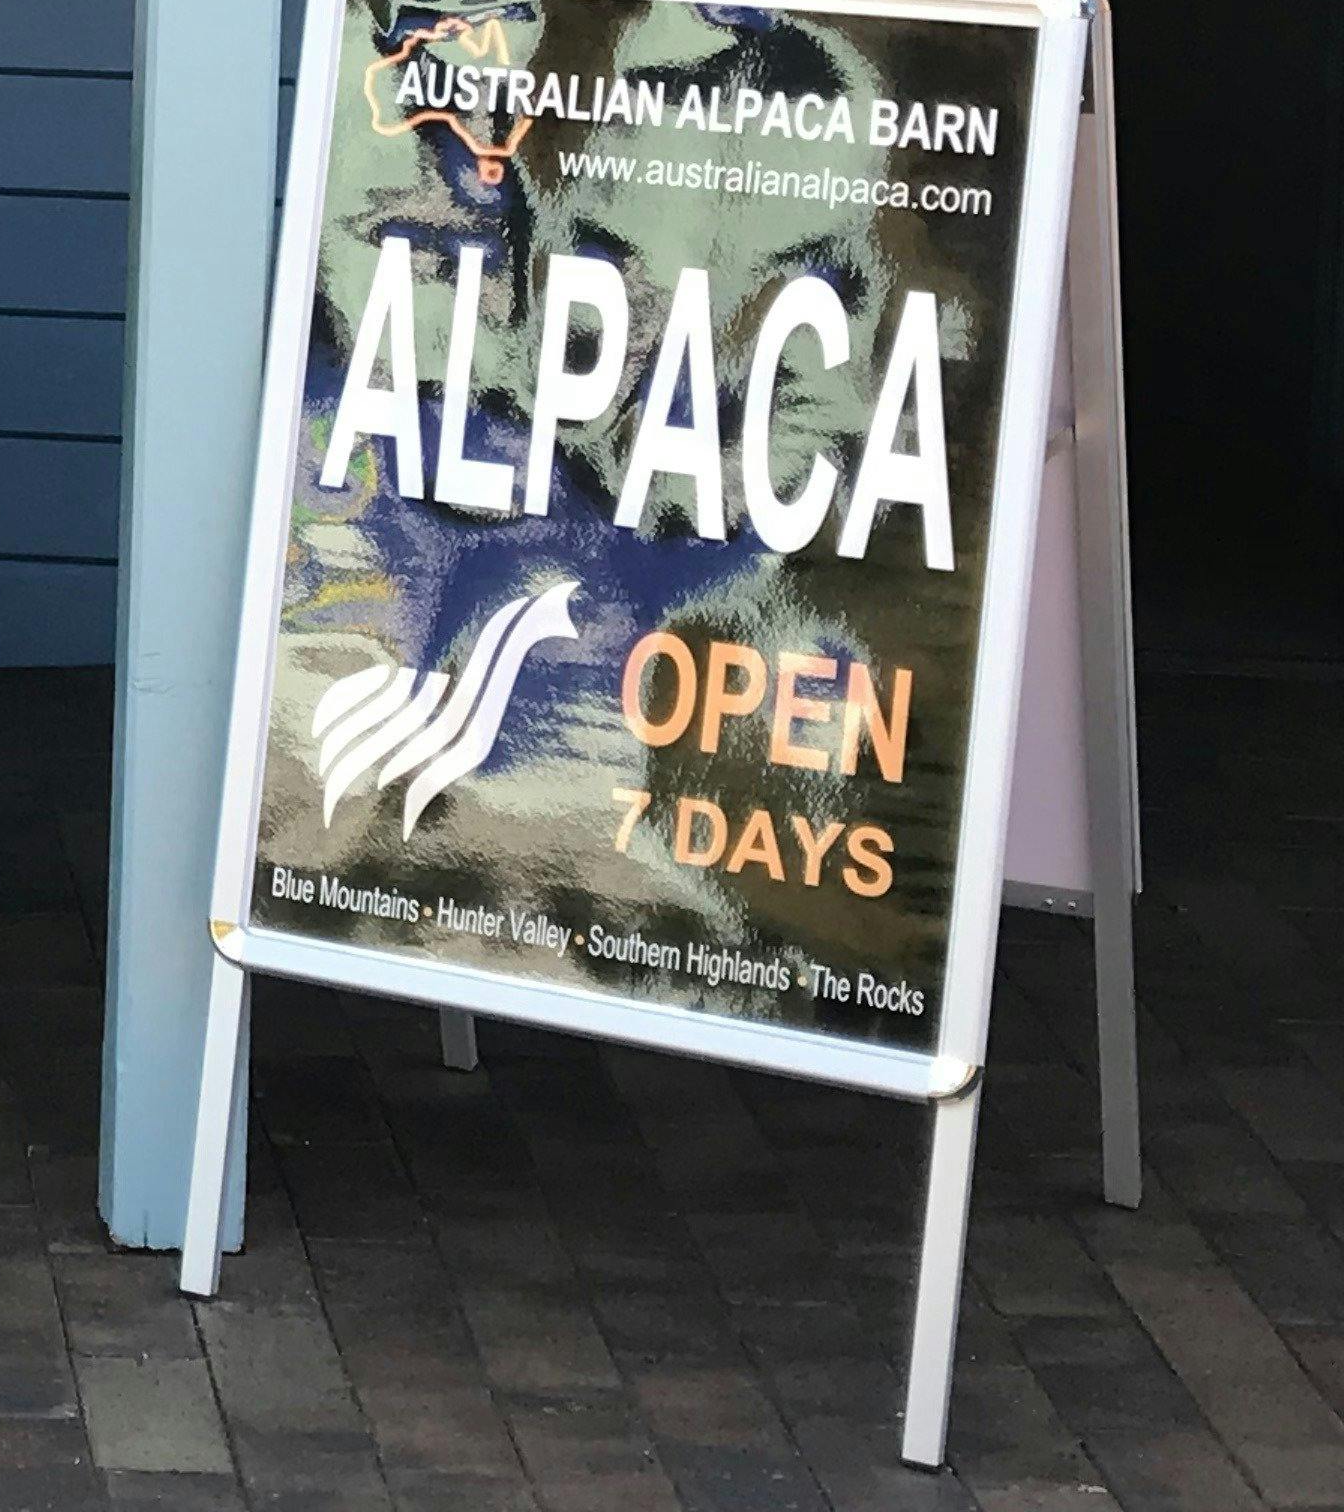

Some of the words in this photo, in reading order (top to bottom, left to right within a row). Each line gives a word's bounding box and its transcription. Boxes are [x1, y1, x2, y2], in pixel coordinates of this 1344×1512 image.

[395, 61, 664, 128] AUSTRALIAN
[676, 85, 855, 144] ALPACA
[868, 102, 1000, 157] BARN
[558, 150, 993, 216] www.australianalpaca.com
[318, 235, 956, 573] ALPACA
[622, 630, 913, 784] OPEN
[611, 788, 652, 852] 7
[675, 799, 895, 897] DAYS
[270, 867, 314, 903] Blue
[319, 875, 420, 924] Mountains
[436, 898, 505, 938] Hunter
[508, 910, 572, 958] Valley
[587, 923, 681, 975] Southern
[686, 940, 791, 992] Highlands
[809, 962, 852, 1000] The
[857, 970, 925, 1017] Rocks
